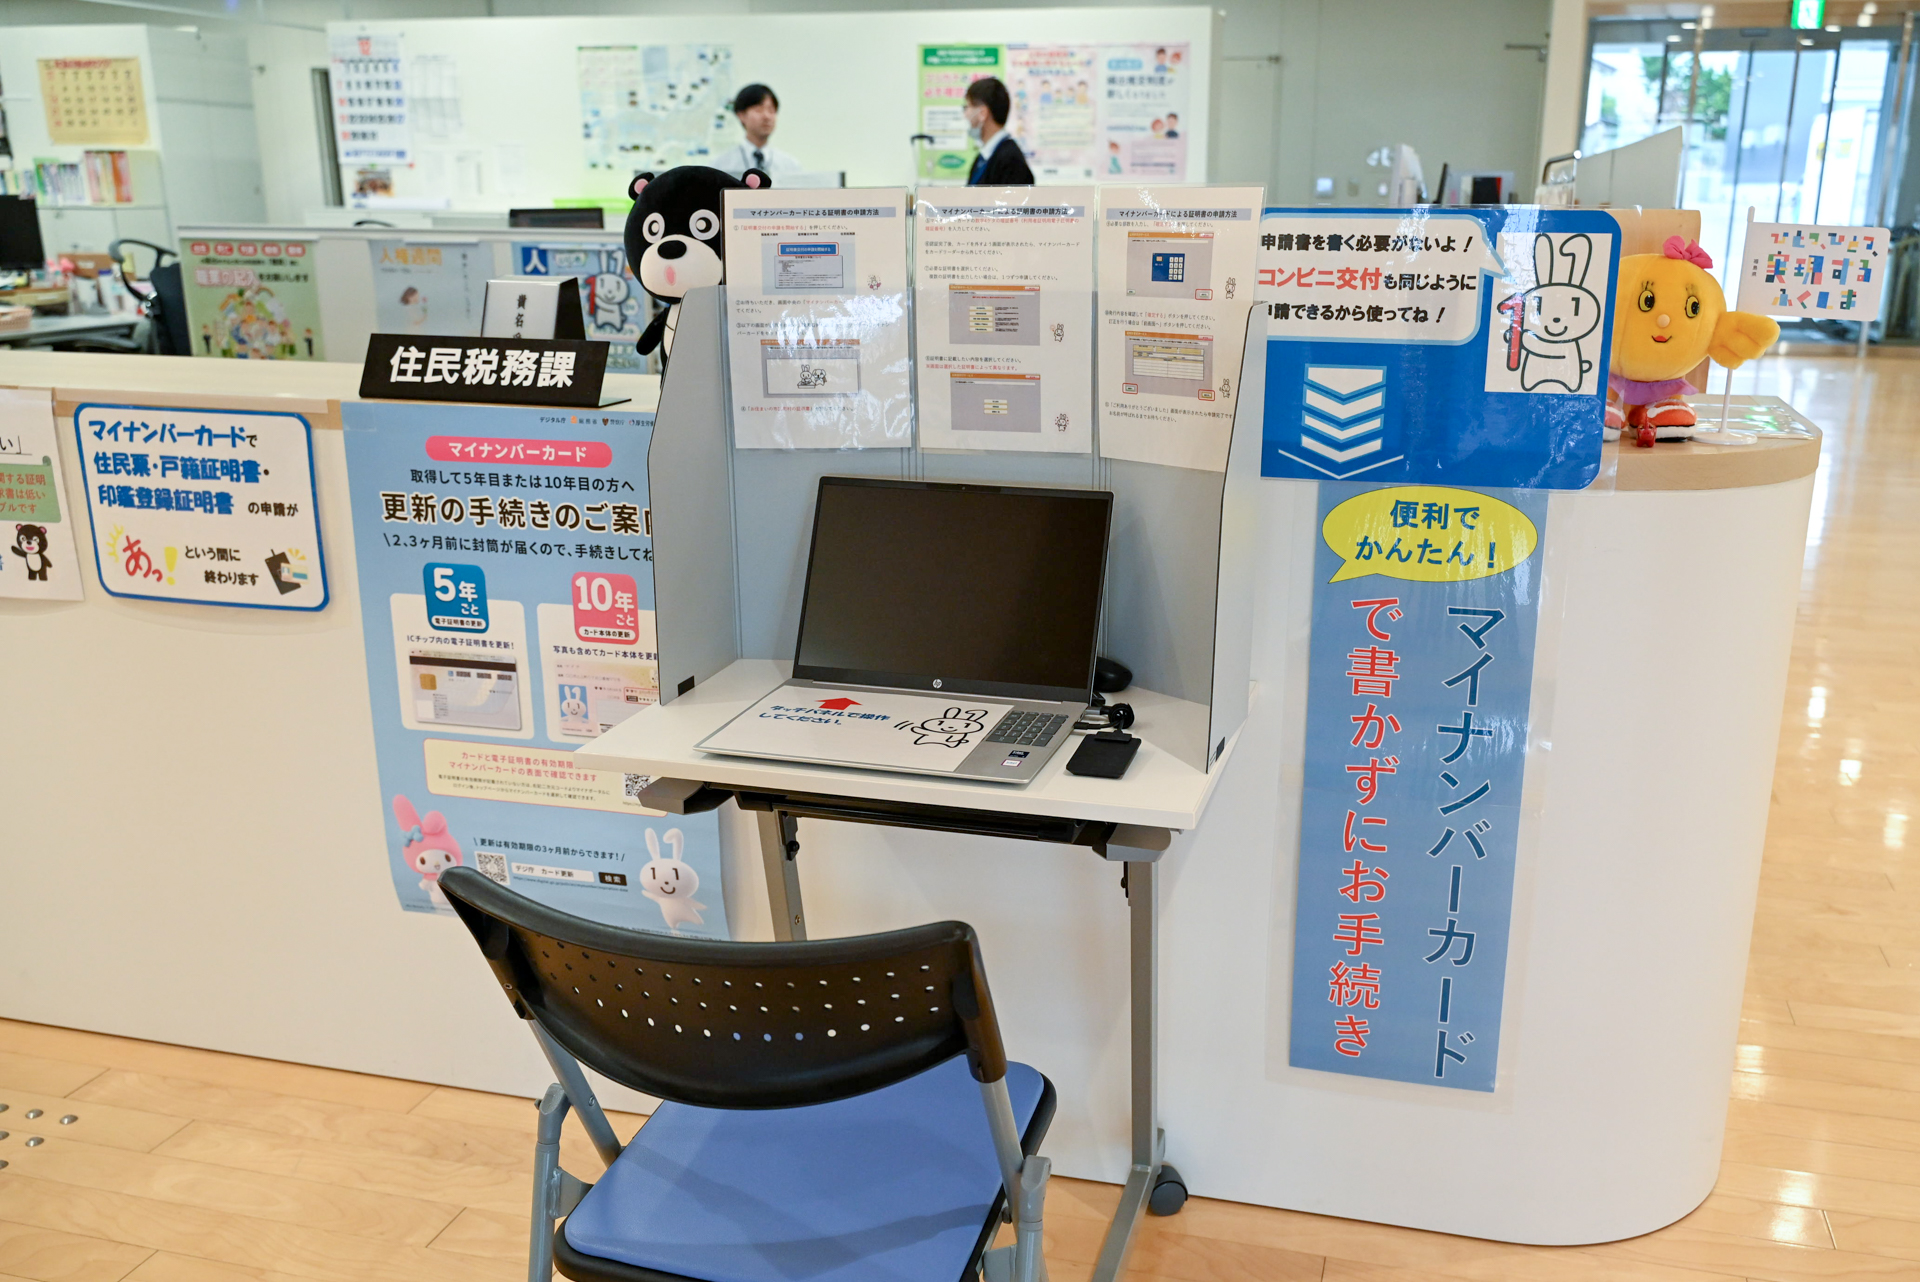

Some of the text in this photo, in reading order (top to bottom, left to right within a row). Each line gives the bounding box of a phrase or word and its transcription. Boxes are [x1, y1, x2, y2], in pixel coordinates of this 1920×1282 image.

[750, 208, 879, 217] マイナンバーカードによる証明書の申請方法
[1119, 209, 1238, 219] マイナンバーカードによる証明書の申請方法
[1261, 233, 1474, 253] 申請書を書く必要がないよ！
[379, 247, 443, 266] 人権週間
[1765, 251, 1872, 285] 実現する
[1258, 267, 1477, 291] コンビニ交付も同じように
[1771, 288, 1857, 310] ふくしま
[1267, 303, 1446, 323] 請できるから使ってね！
[389, 346, 577, 388] 住民税務課
[88, 420, 258, 448] マイナンバーカードで
[448, 442, 587, 462] マイナンバーカード
[410, 469, 635, 493] 取得して5年目または10年目の方へ
[98, 484, 299, 517] 印鑑登録証明書 の申請が
[1390, 499, 1480, 531] 便利で
[185, 546, 241, 562] という間に
[1354, 535, 1496, 569] かんたん！
[204, 570, 259, 586] 終わります
[461, 603, 479, 616] ごと
[435, 617, 483, 628] 電子証明書の更新
[616, 614, 635, 627] ごと
[407, 634, 515, 651] ICチップ内の電子証明書を更新！
[584, 628, 631, 639] カード本体の更新
[770, 705, 891, 721] タッチパネルで操作
[461, 751, 582, 769] カードと電子証明書の有効期限
[449, 761, 598, 782] マイナンバーカードの表面で確認できます
[1327, 597, 1403, 1058] で書かずにお手続き
[1422, 605, 1506, 1079] マイナンバーカード
[515, 864, 574, 878] デジ庁 カード更新
[604, 875, 621, 884] 検索
